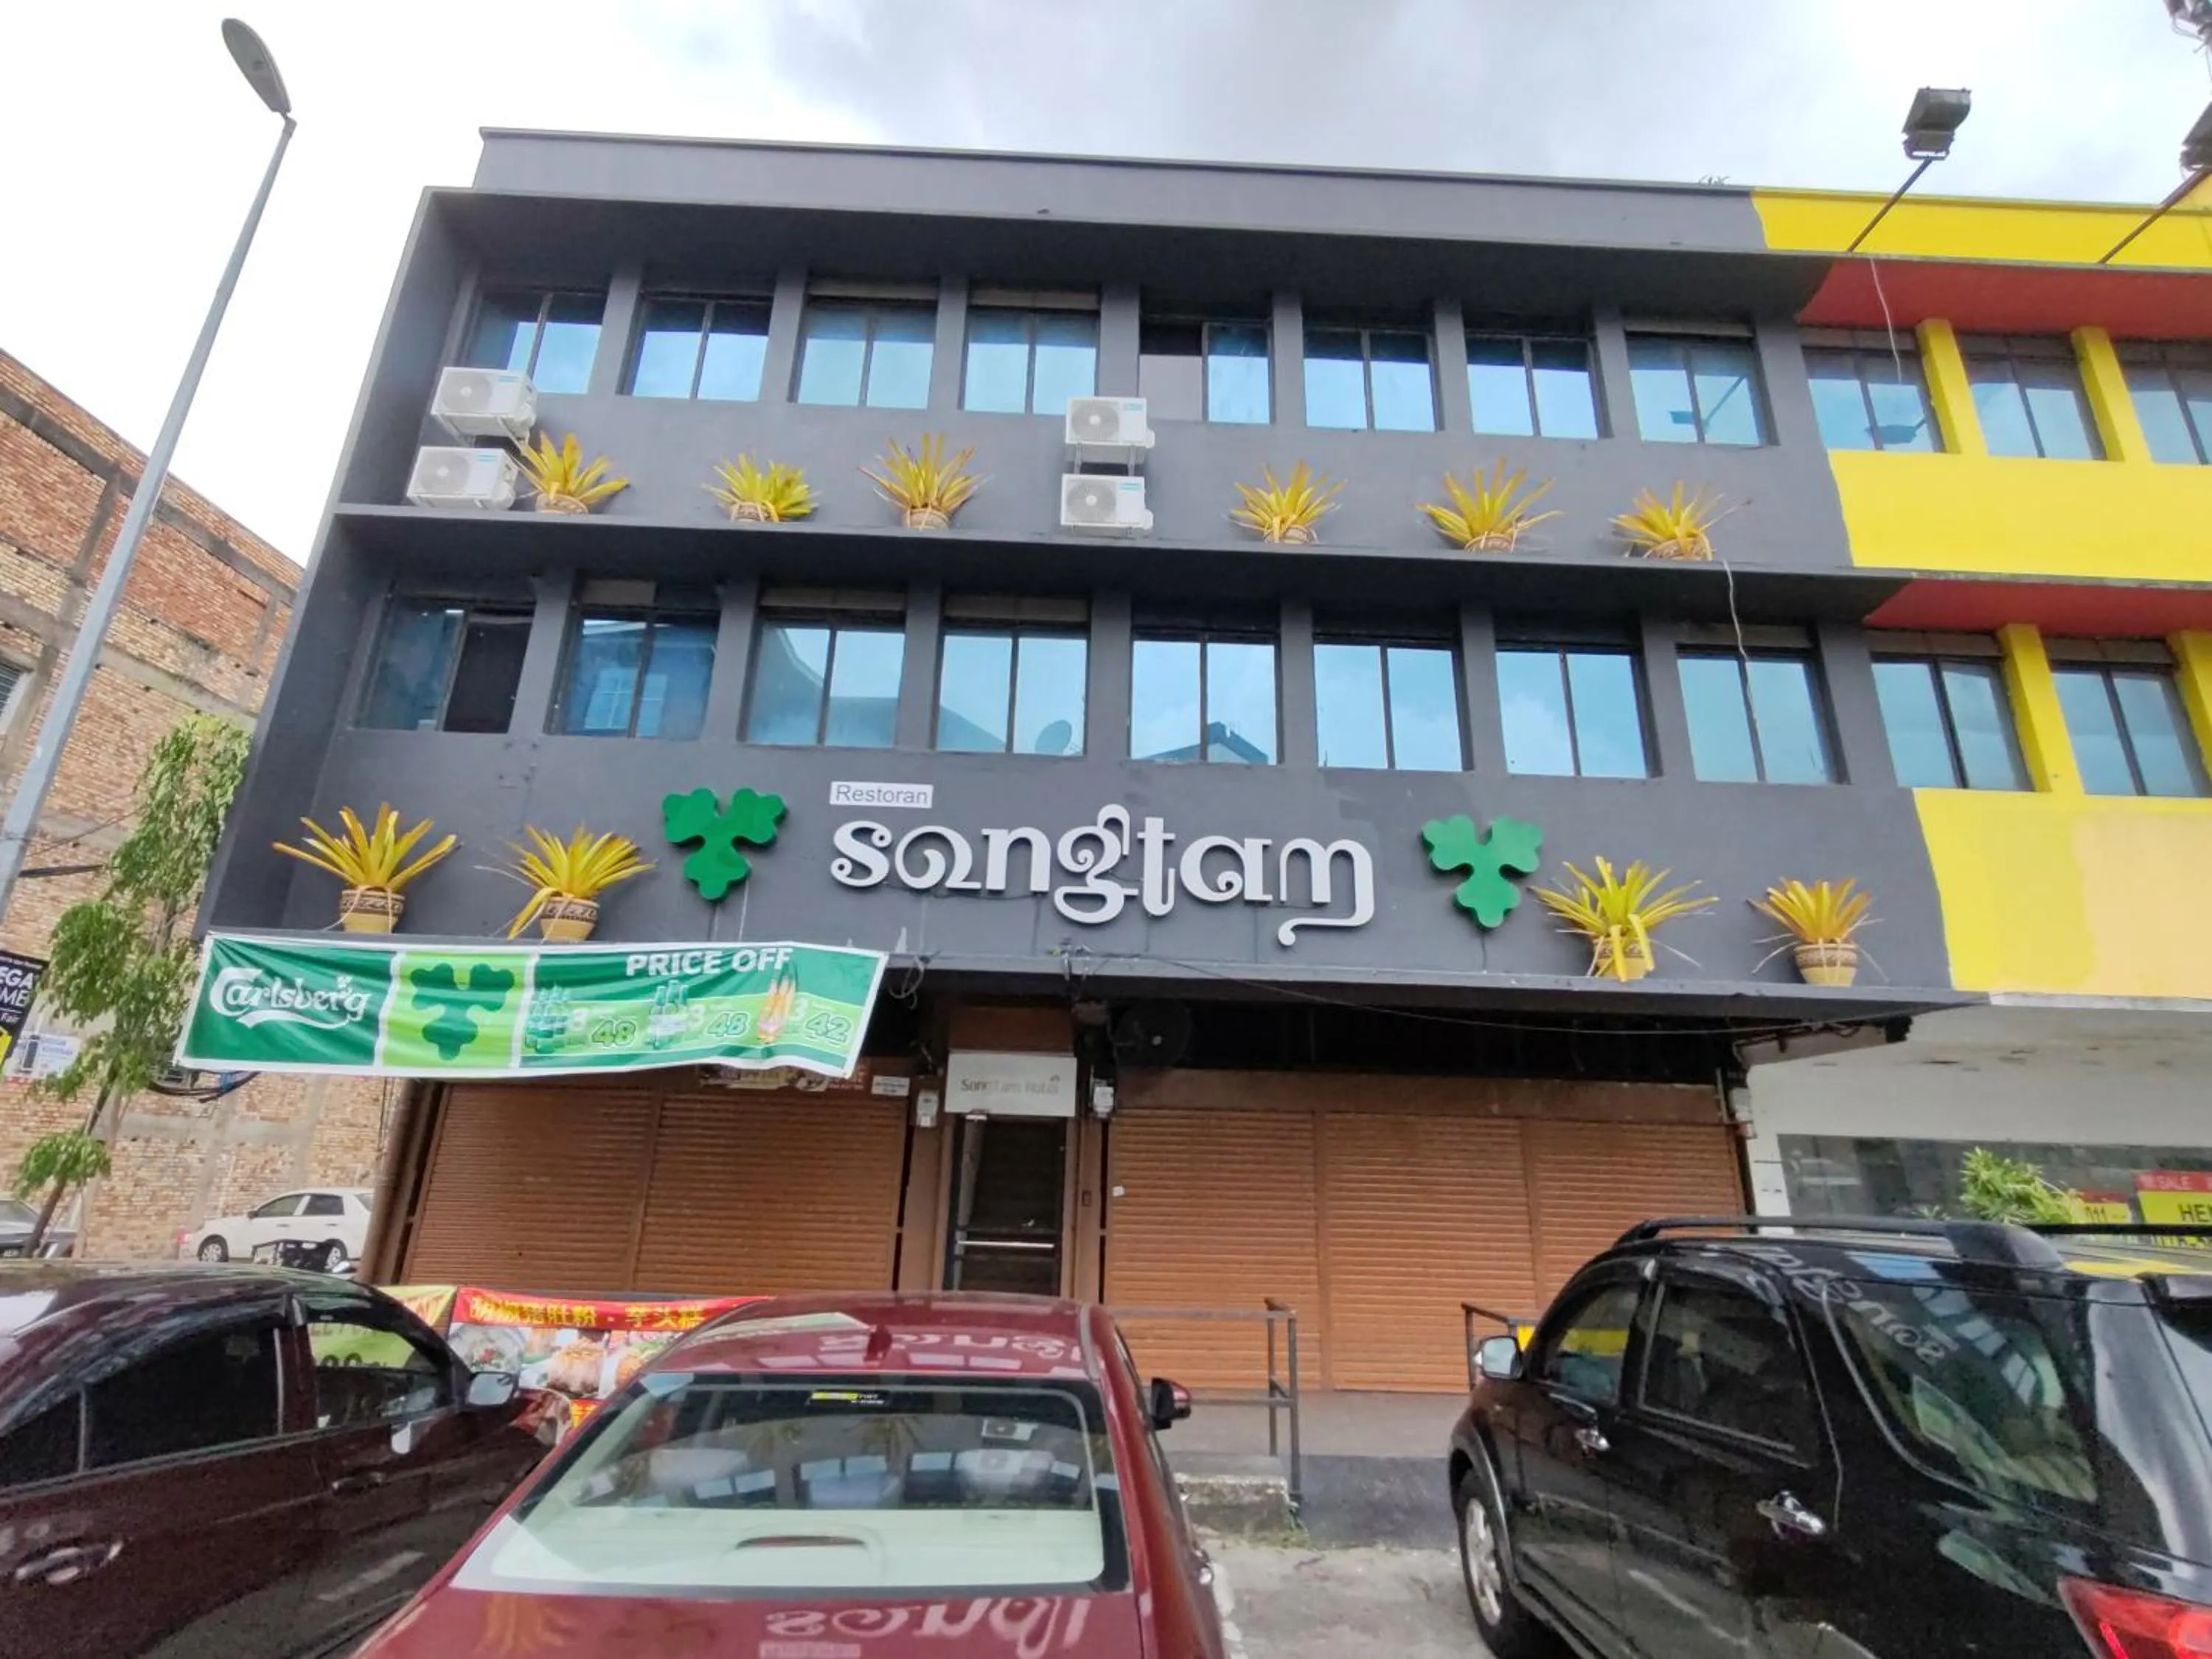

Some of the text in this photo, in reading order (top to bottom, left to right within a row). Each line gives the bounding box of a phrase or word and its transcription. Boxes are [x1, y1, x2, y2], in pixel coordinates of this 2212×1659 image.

[836, 785, 928, 804] Restoran
[625, 947, 794, 976] PRICE OFF
[209, 967, 372, 1029] Carlsberg
[591, 1017, 639, 1048] 48
[804, 1011, 854, 1044] 42
